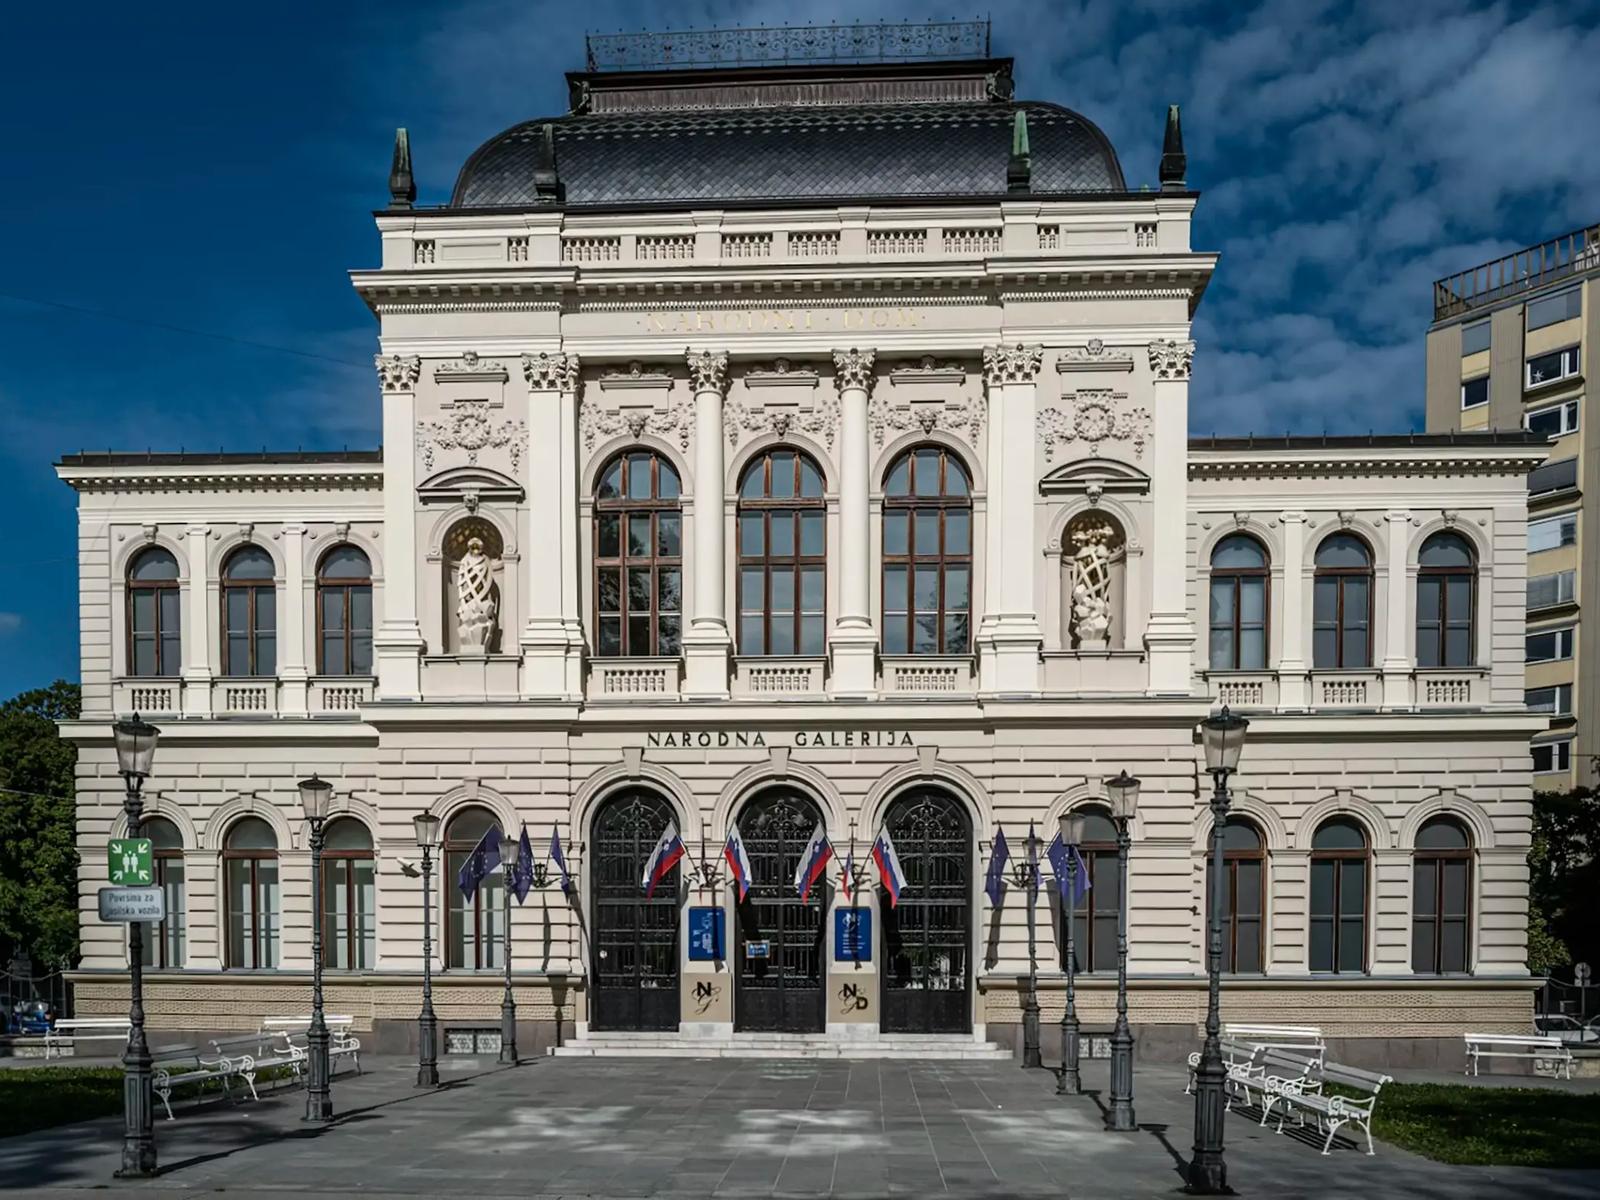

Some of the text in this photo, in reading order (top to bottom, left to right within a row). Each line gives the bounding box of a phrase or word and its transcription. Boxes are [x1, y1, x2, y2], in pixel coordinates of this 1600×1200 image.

[647, 307, 917, 331] NARODNI DOM
[647, 731, 914, 747] NARODNA GALERIJA
